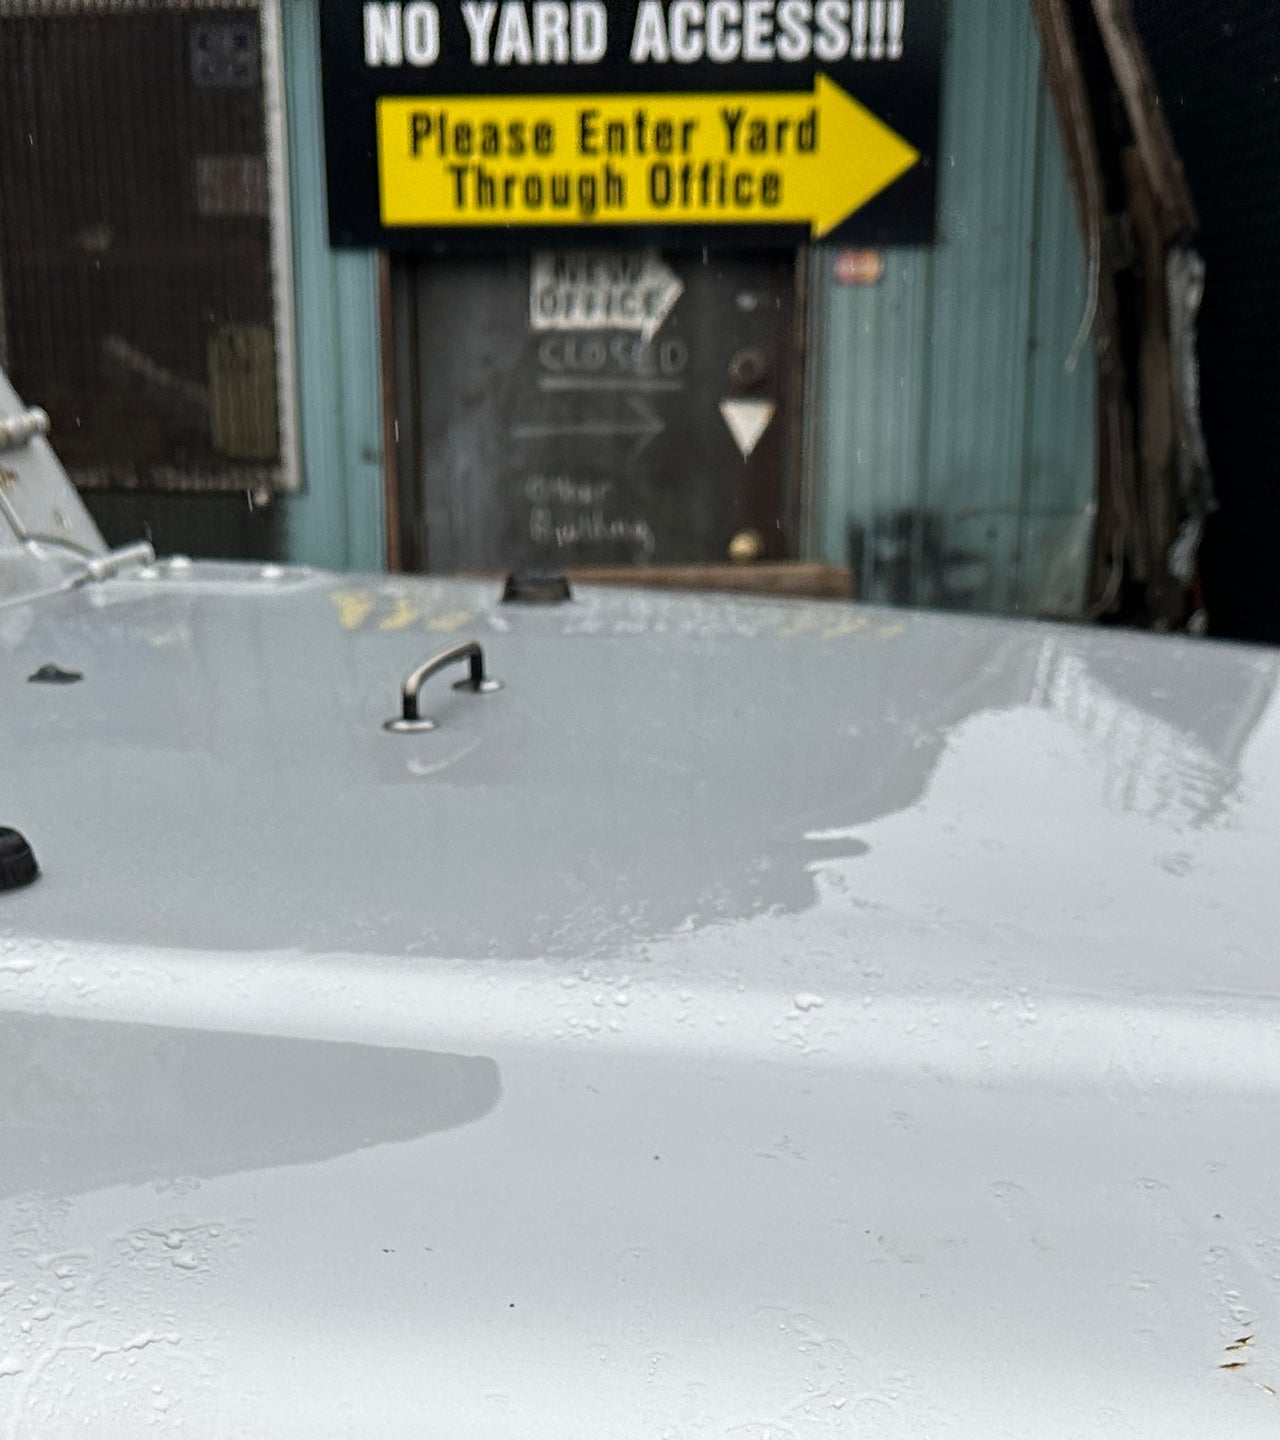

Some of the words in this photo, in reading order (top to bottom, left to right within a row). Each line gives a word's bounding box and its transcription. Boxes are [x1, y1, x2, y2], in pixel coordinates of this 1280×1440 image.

[364, 0, 440, 67] NO
[462, 0, 608, 65] YARD
[631, 0, 905, 61] ACCESS!!!
[410, 109, 554, 159] Please
[578, 108, 698, 156] Enter
[722, 106, 819, 154] Yard
[448, 164, 628, 217] Through
[648, 163, 783, 210] Office
